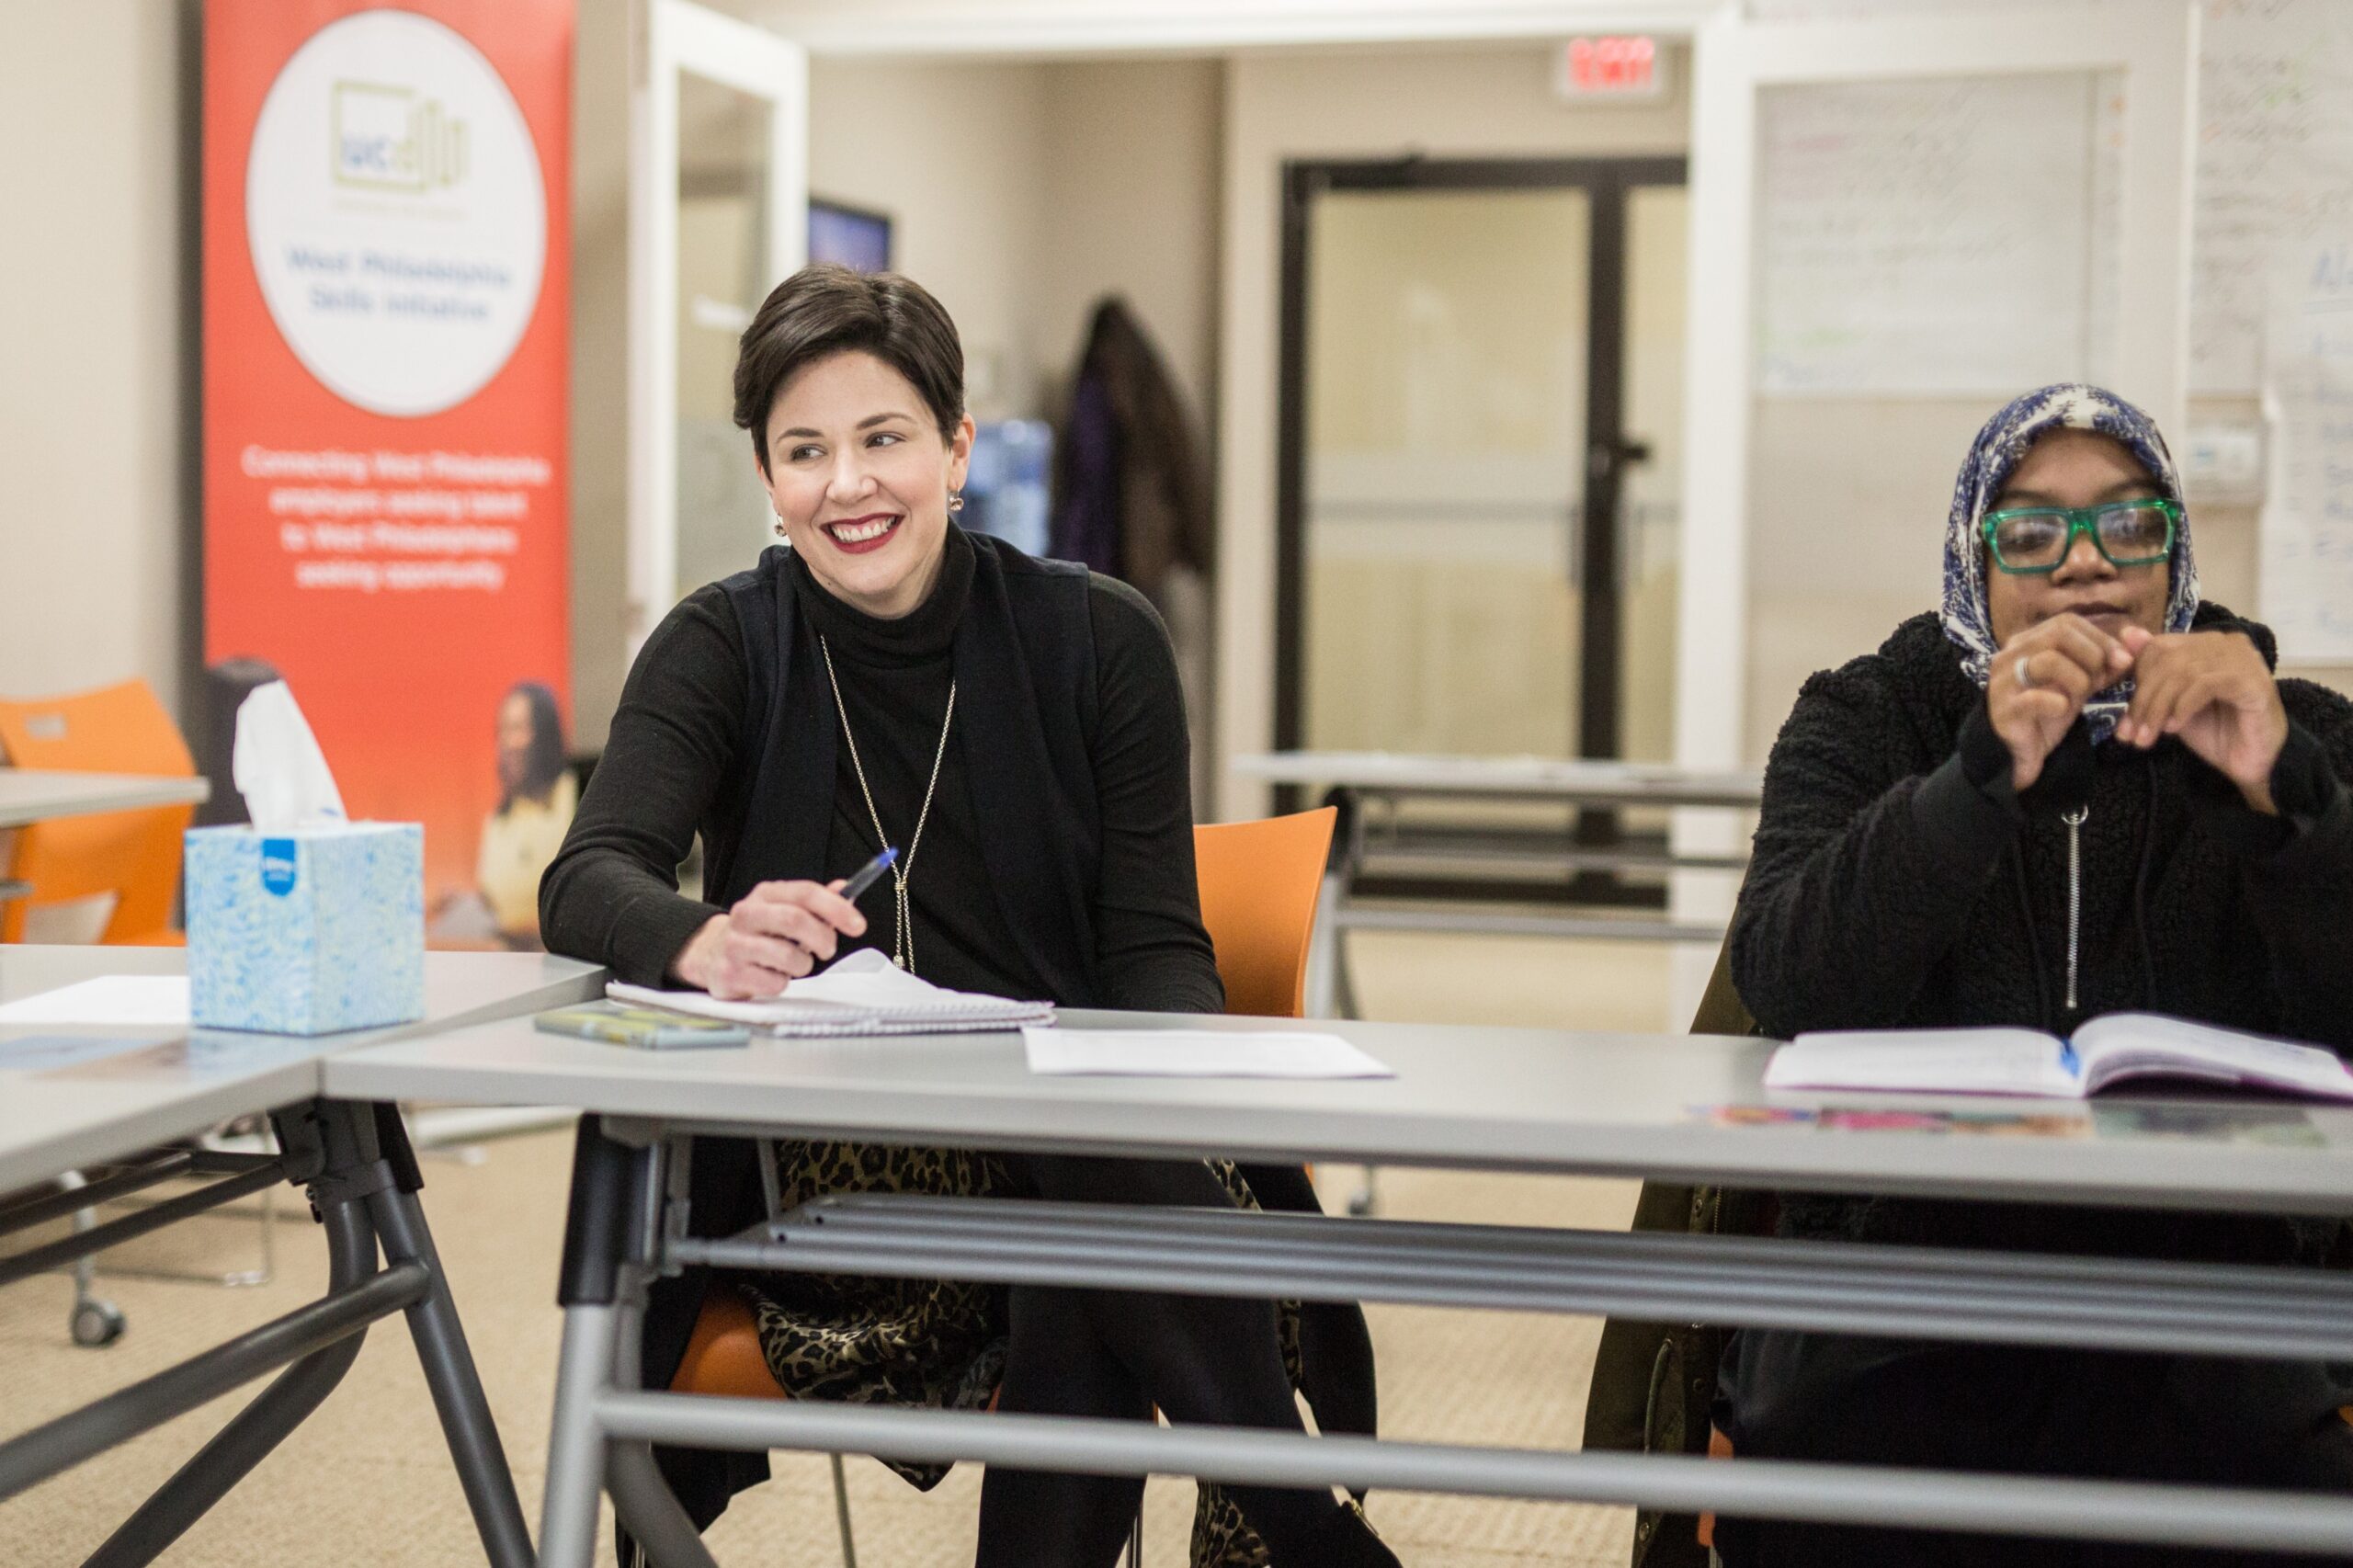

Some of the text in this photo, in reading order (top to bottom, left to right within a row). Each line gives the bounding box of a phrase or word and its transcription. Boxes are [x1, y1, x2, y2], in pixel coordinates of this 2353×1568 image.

[287, 243, 514, 290] West Philadelphia
[310, 285, 491, 323] Skills Initiative
[240, 445, 550, 486] Connecting West Philadelphia
[268, 487, 527, 520] employers seeking talent
[280, 522, 308, 551] to
[313, 523, 367, 550] West
[295, 561, 503, 593] seeking opportunity
